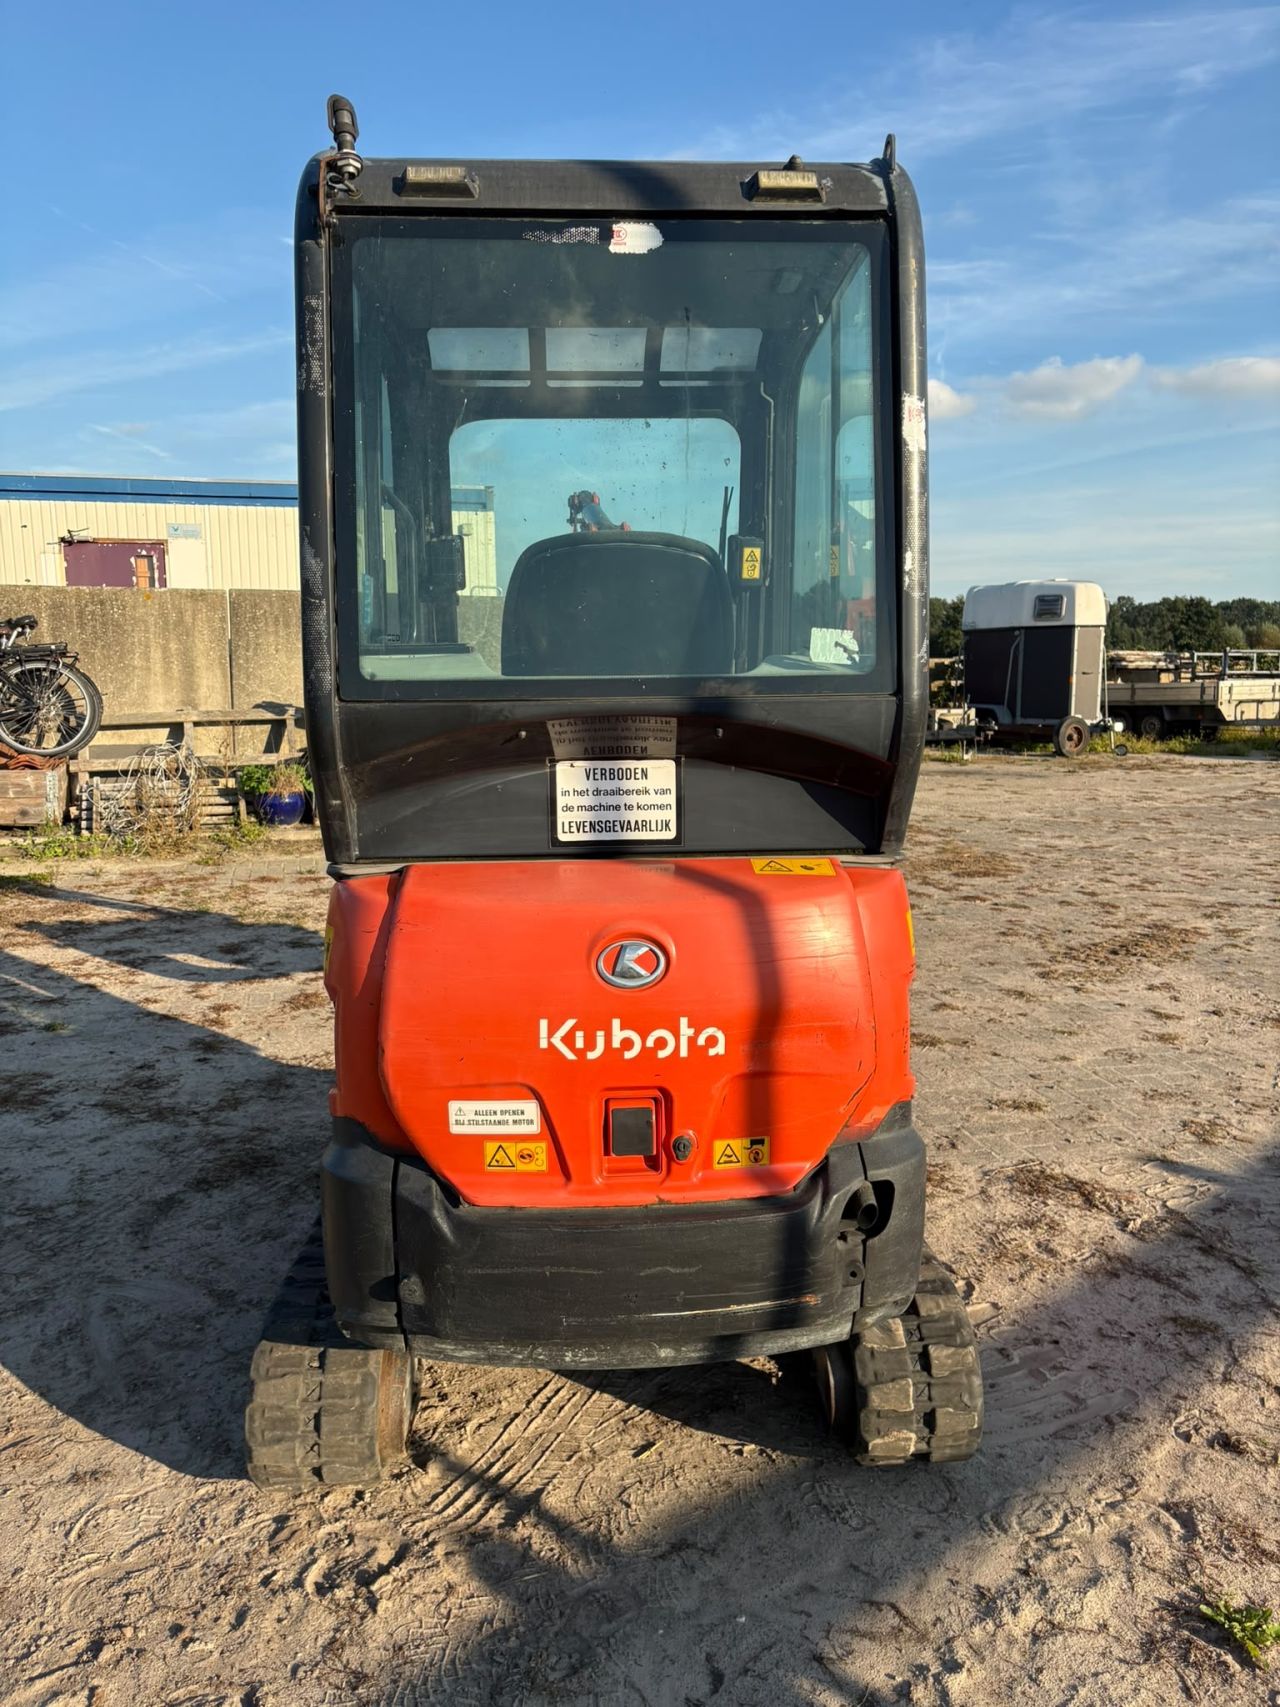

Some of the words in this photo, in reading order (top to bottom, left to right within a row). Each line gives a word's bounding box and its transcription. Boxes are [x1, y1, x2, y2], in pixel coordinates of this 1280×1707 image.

[584, 767, 649, 781] VERBODEN
[561, 787, 570, 797] in
[573, 787, 590, 797] het
[592, 786, 651, 796] draaibereik
[653, 787, 672, 796] van
[561, 803, 575, 812] de
[577, 802, 621, 812] machine
[624, 803, 634, 811] te
[636, 802, 672, 811] komen
[561, 819, 672, 834] LEVENSGEVAARLIJK
[539, 1016, 726, 1060] Kubota
[512, 1118, 535, 1126] MOTOR
